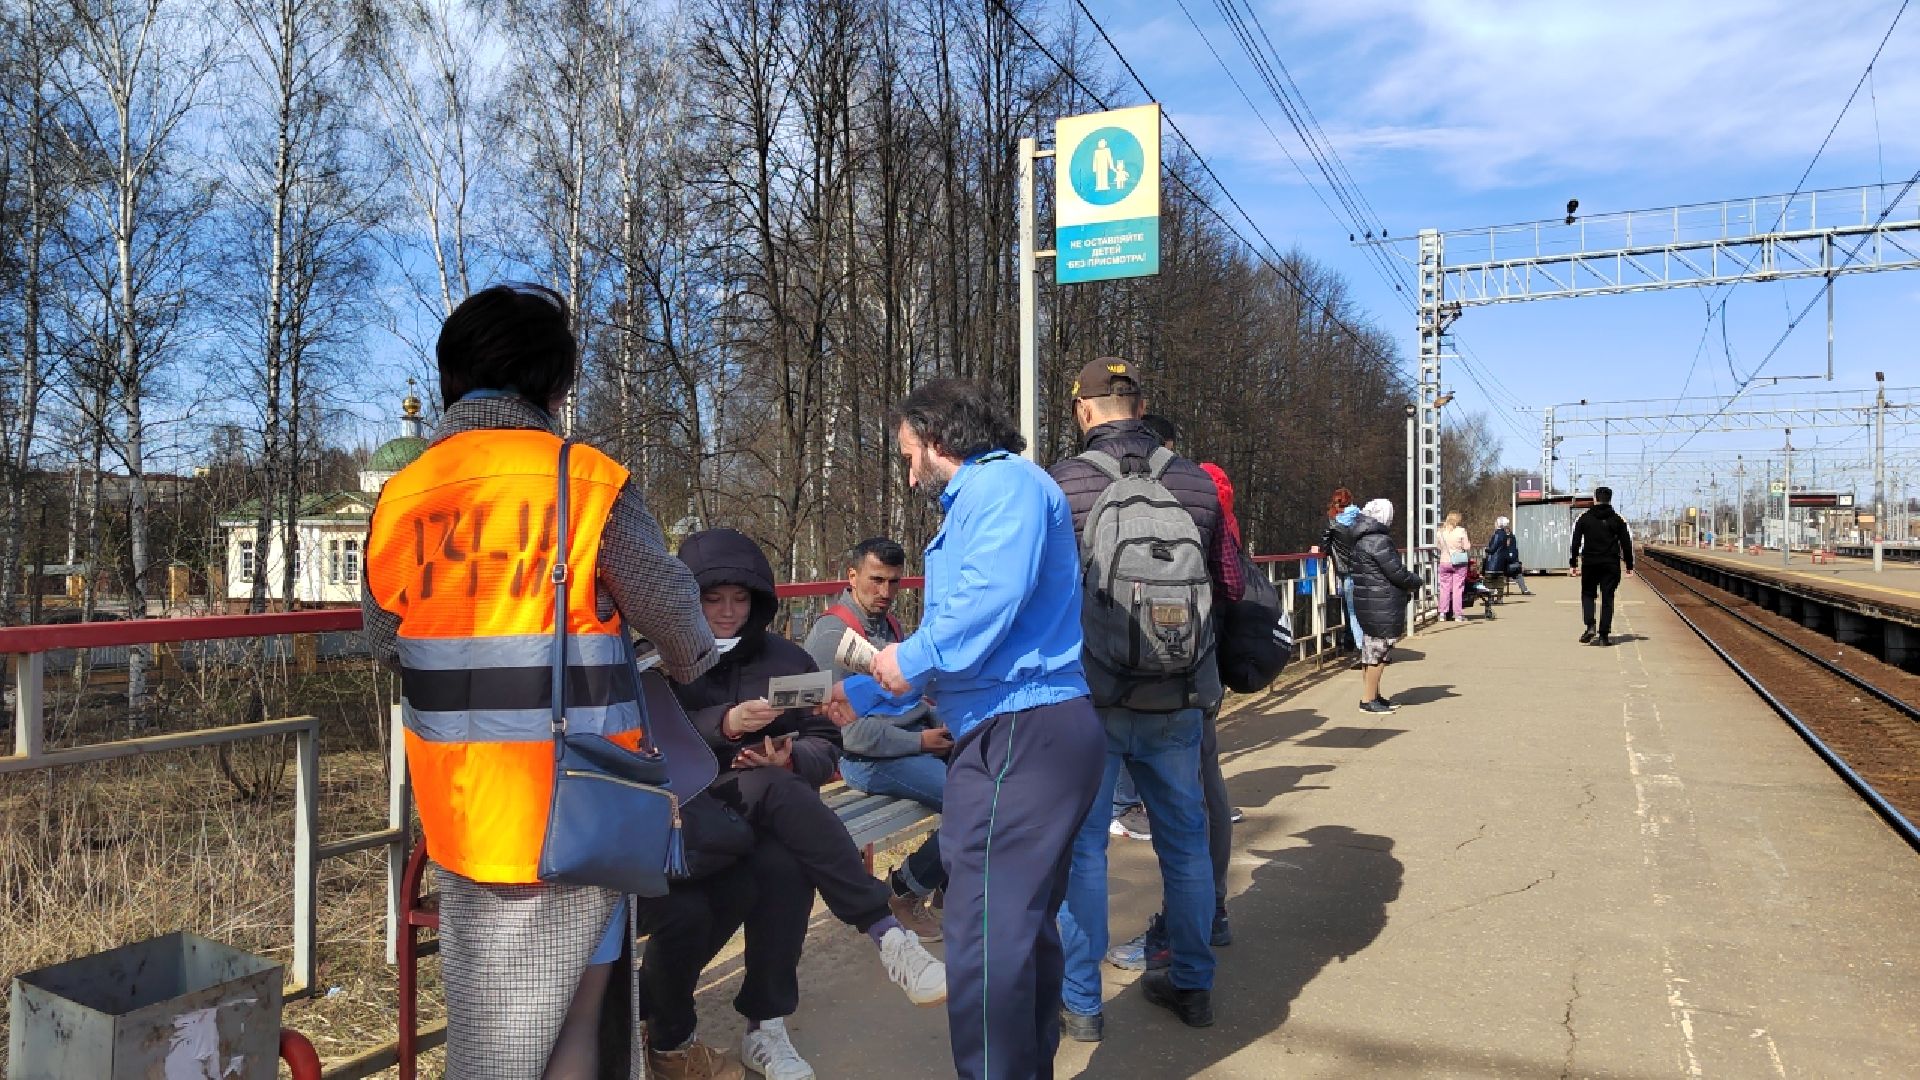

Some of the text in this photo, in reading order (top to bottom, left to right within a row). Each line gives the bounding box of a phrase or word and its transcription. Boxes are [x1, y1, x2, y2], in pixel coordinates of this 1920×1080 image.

[1070, 232, 1144, 249] НЕ ОСТАВЛЯЙТЕ
[1092, 244, 1121, 256] ДЕТЕЙ
[1067, 252, 1147, 269] БЕЗ ПРИСМОТРА!
[1526, 479, 1532, 490] 1
